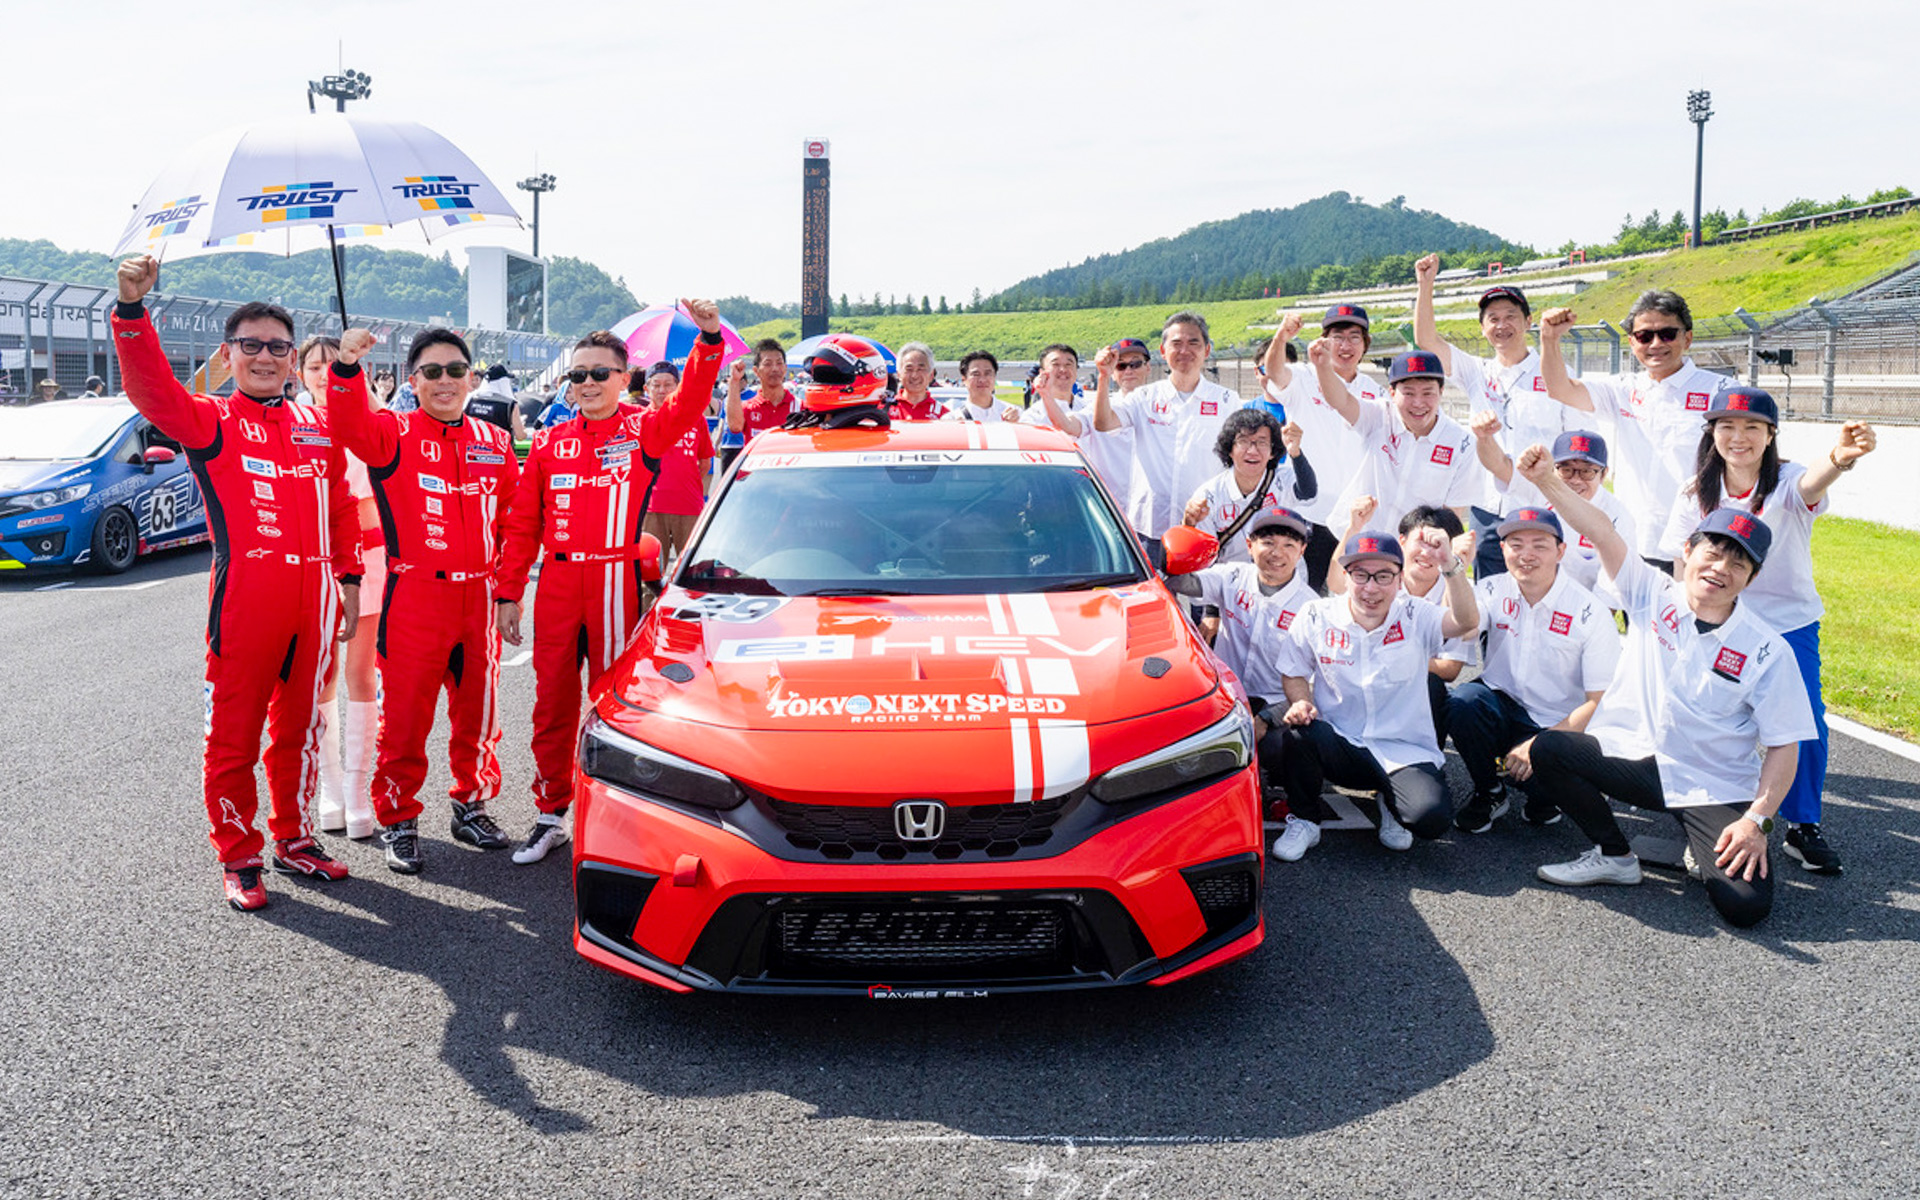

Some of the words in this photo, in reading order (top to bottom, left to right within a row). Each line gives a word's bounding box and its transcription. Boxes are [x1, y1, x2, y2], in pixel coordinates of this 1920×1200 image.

[237, 188, 358, 211] TRUST
[392, 183, 480, 198] TRUST
[144, 201, 209, 227] TRUST
[152, 494, 175, 532] 63
[873, 615, 990, 623] YOKOHAMA
[873, 694, 964, 714] NEXT
[965, 694, 1066, 714] SPEED
[851, 715, 919, 723] RACING
[932, 713, 982, 722] TEAM
